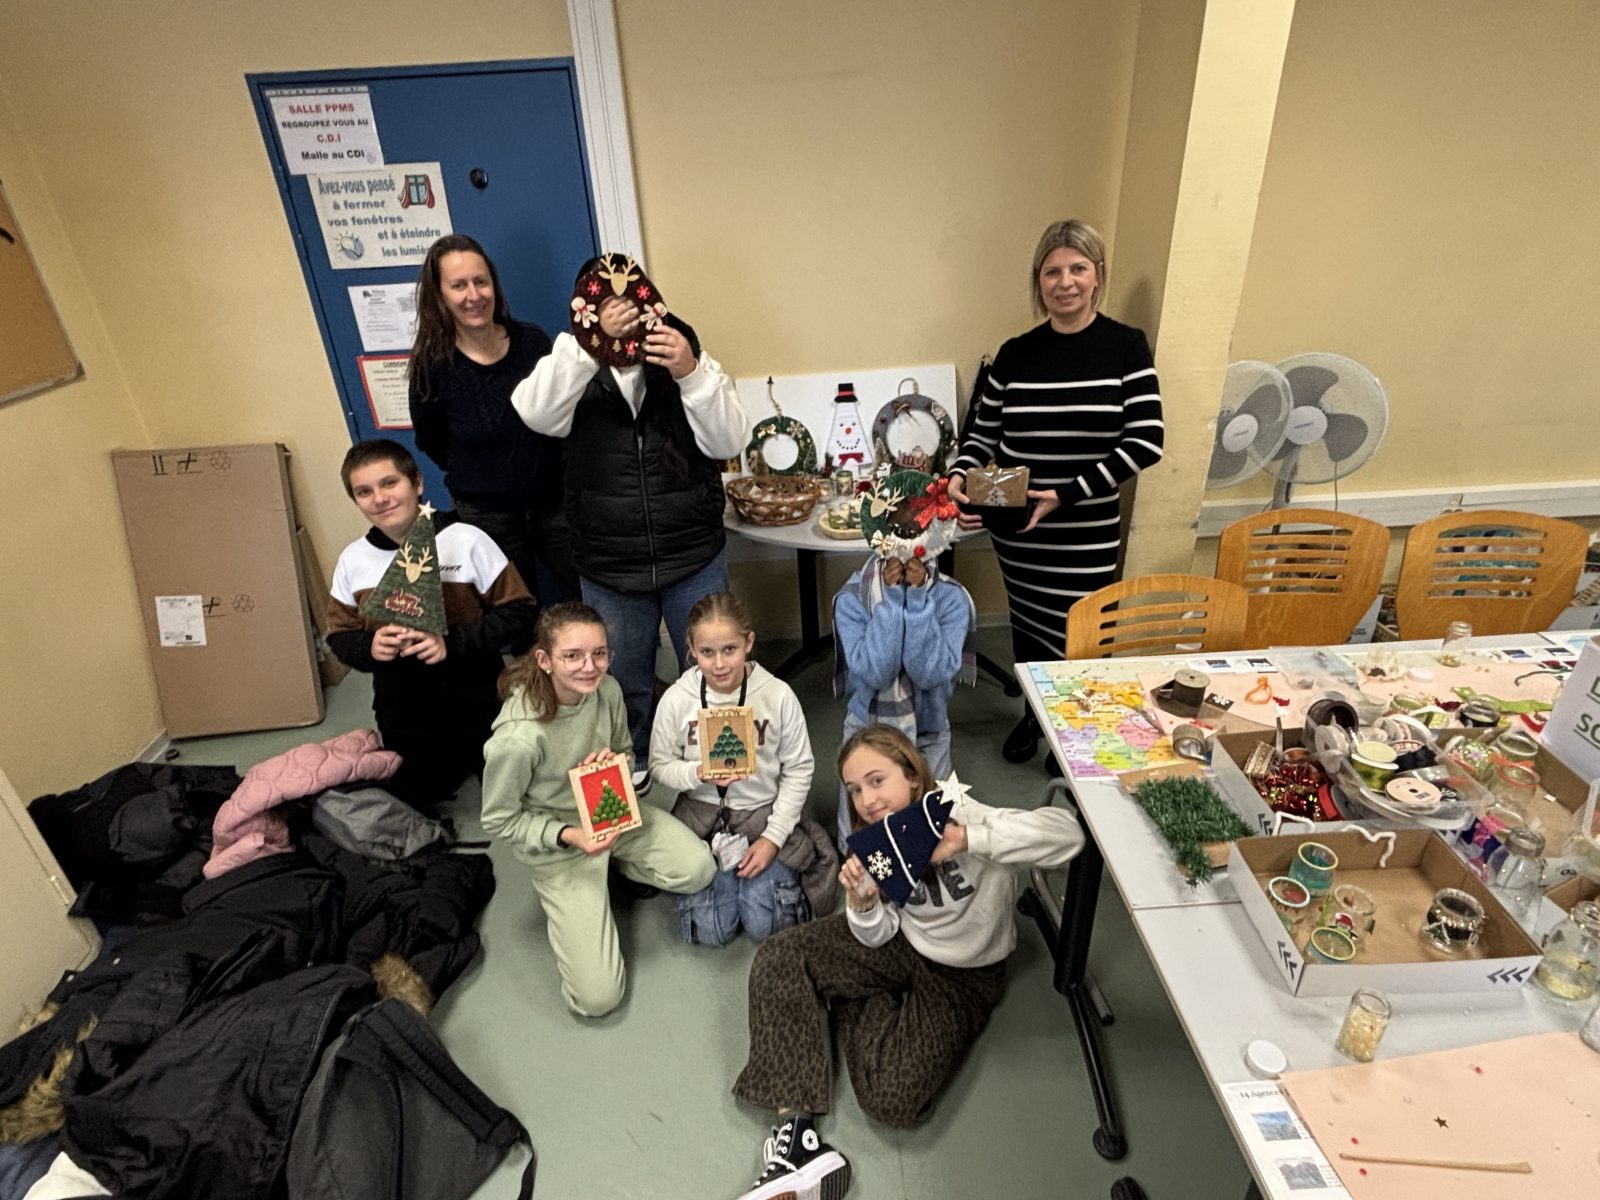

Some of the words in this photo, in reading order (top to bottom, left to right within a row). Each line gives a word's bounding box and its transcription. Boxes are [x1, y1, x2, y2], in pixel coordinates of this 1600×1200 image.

[288, 103, 322, 114] SALLE
[325, 103, 355, 112] PPMS
[281, 119, 331, 128] REGROUPEZ
[333, 119, 355, 127] VOUS
[316, 134, 342, 143] C.D.I
[301, 151, 328, 160] Malle
[331, 152, 344, 160] au
[346, 150, 365, 159] CDI
[318, 178, 366, 195] Avez-vous
[367, 174, 396, 196] pensé
[332, 200, 340, 210] à
[343, 199, 386, 210] fermer
[327, 219, 348, 227] vos
[351, 214, 404, 226] fenêtres
[377, 229, 389, 240] et
[400, 226, 441, 239] éteindre
[381, 246, 398, 257] les
[399, 244, 430, 256] lumiè
